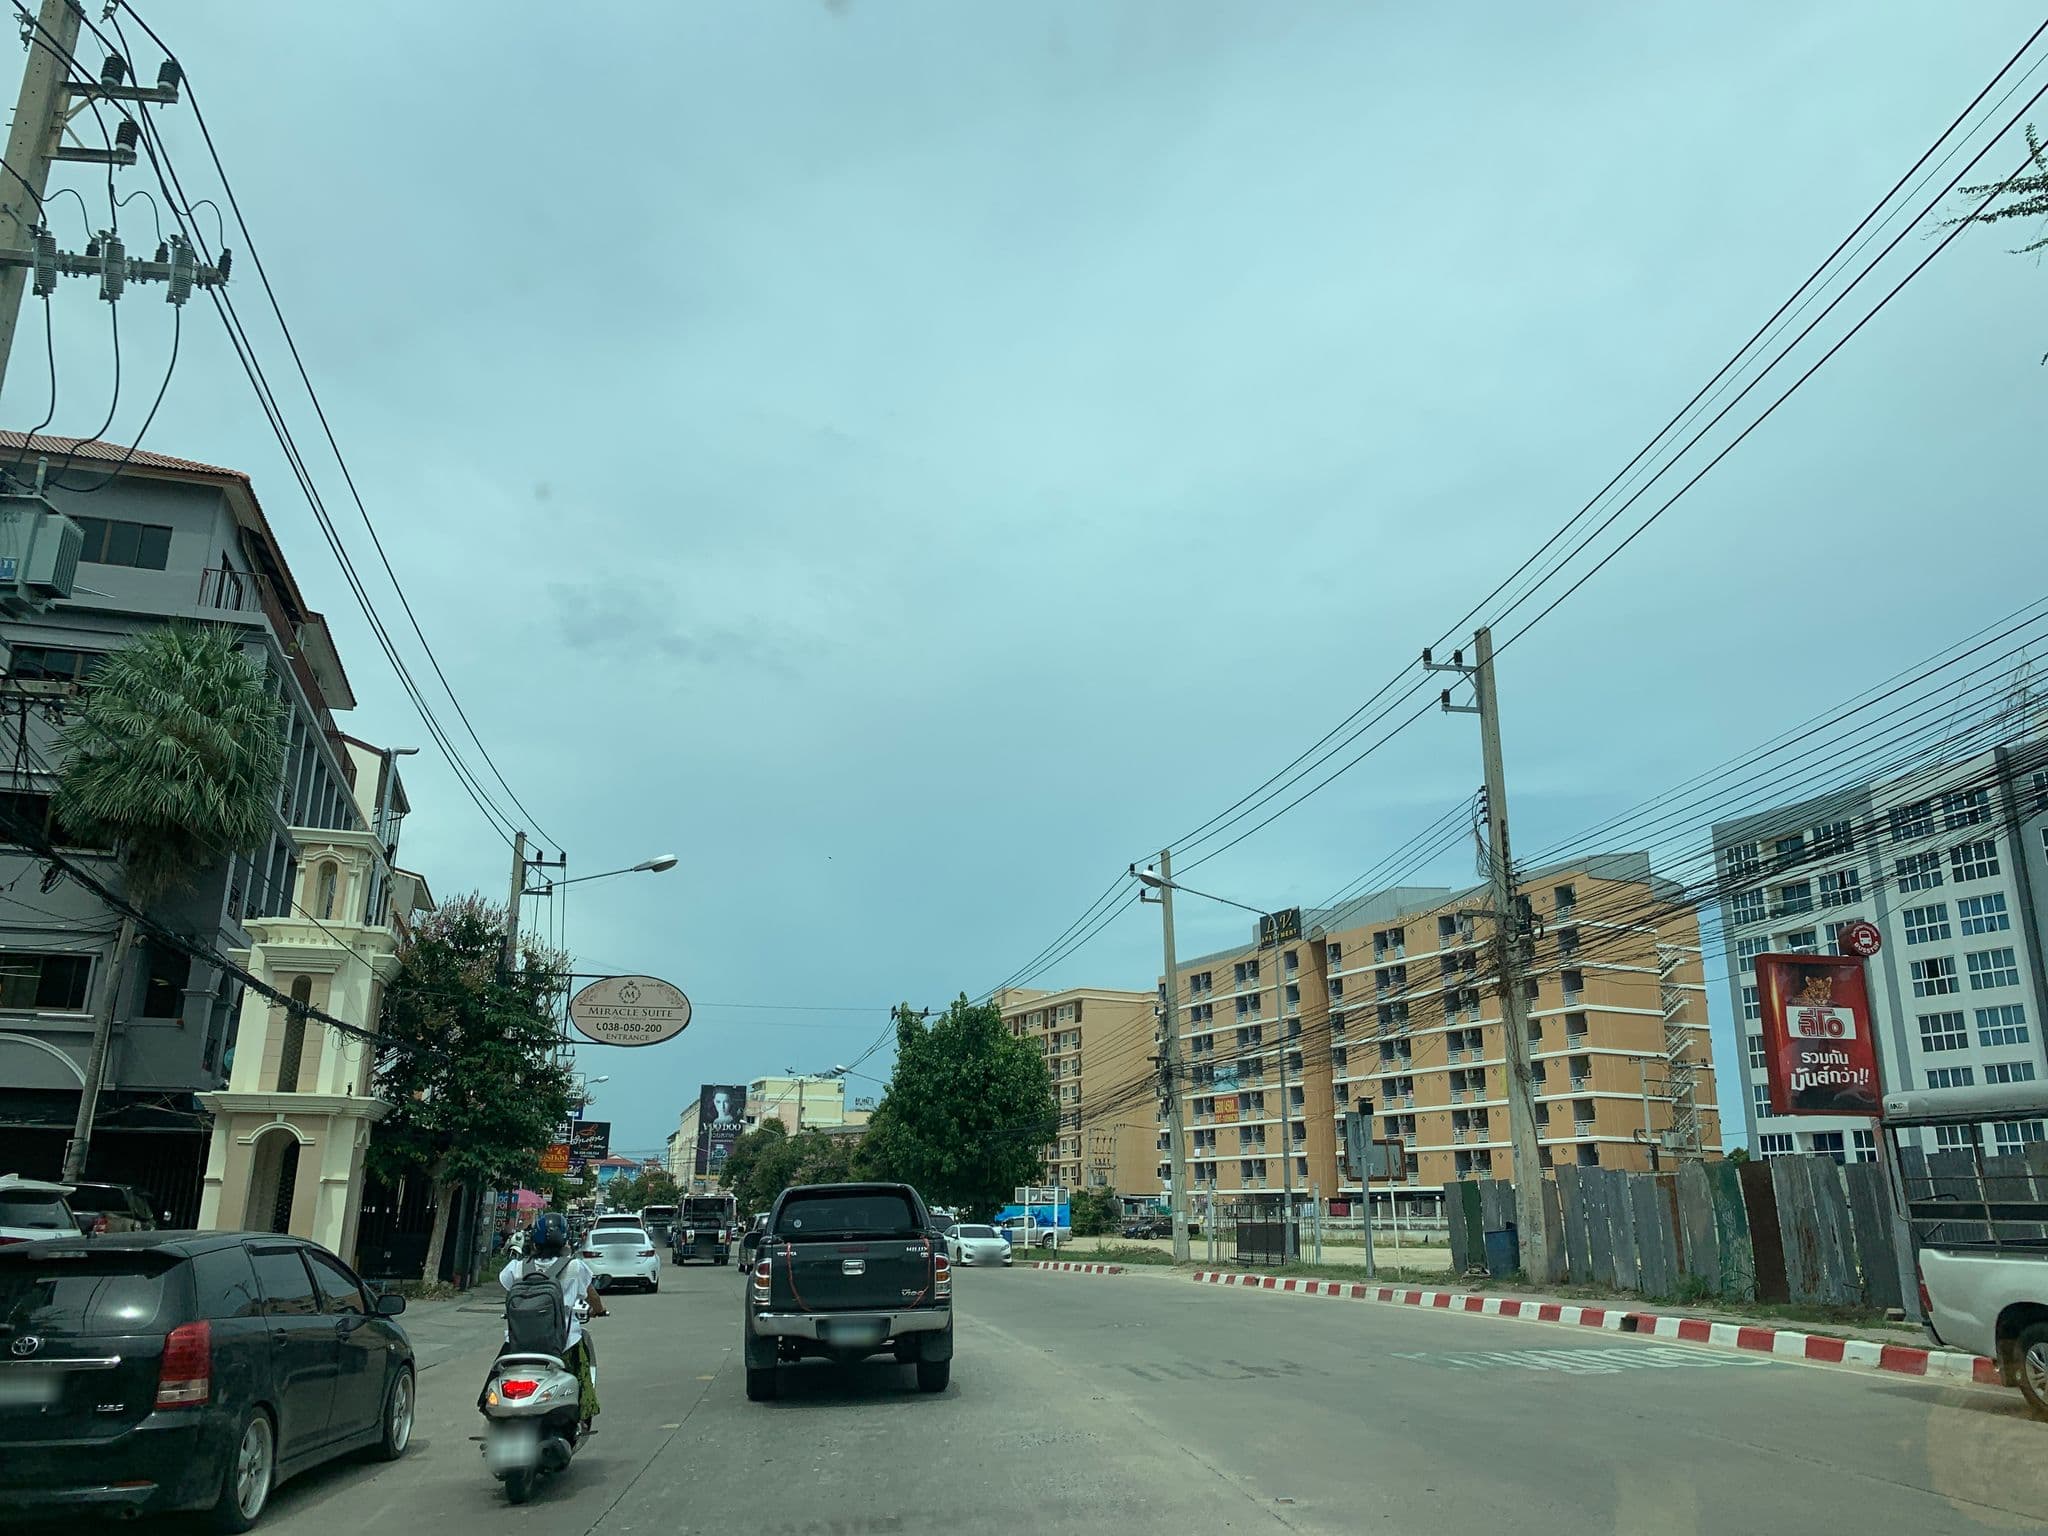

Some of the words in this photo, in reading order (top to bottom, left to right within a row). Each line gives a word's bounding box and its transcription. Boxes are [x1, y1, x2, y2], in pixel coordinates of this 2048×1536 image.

[589, 1007, 639, 1017] MIRACLE
[642, 1008, 673, 1018] SUITE
[602, 1022, 662, 1033] 038-050-200
[1798, 1008, 1845, 1038] ลีโอ
[606, 1033, 650, 1041] ENTRANCE
[1801, 1049, 1849, 1065] รวมกัน
